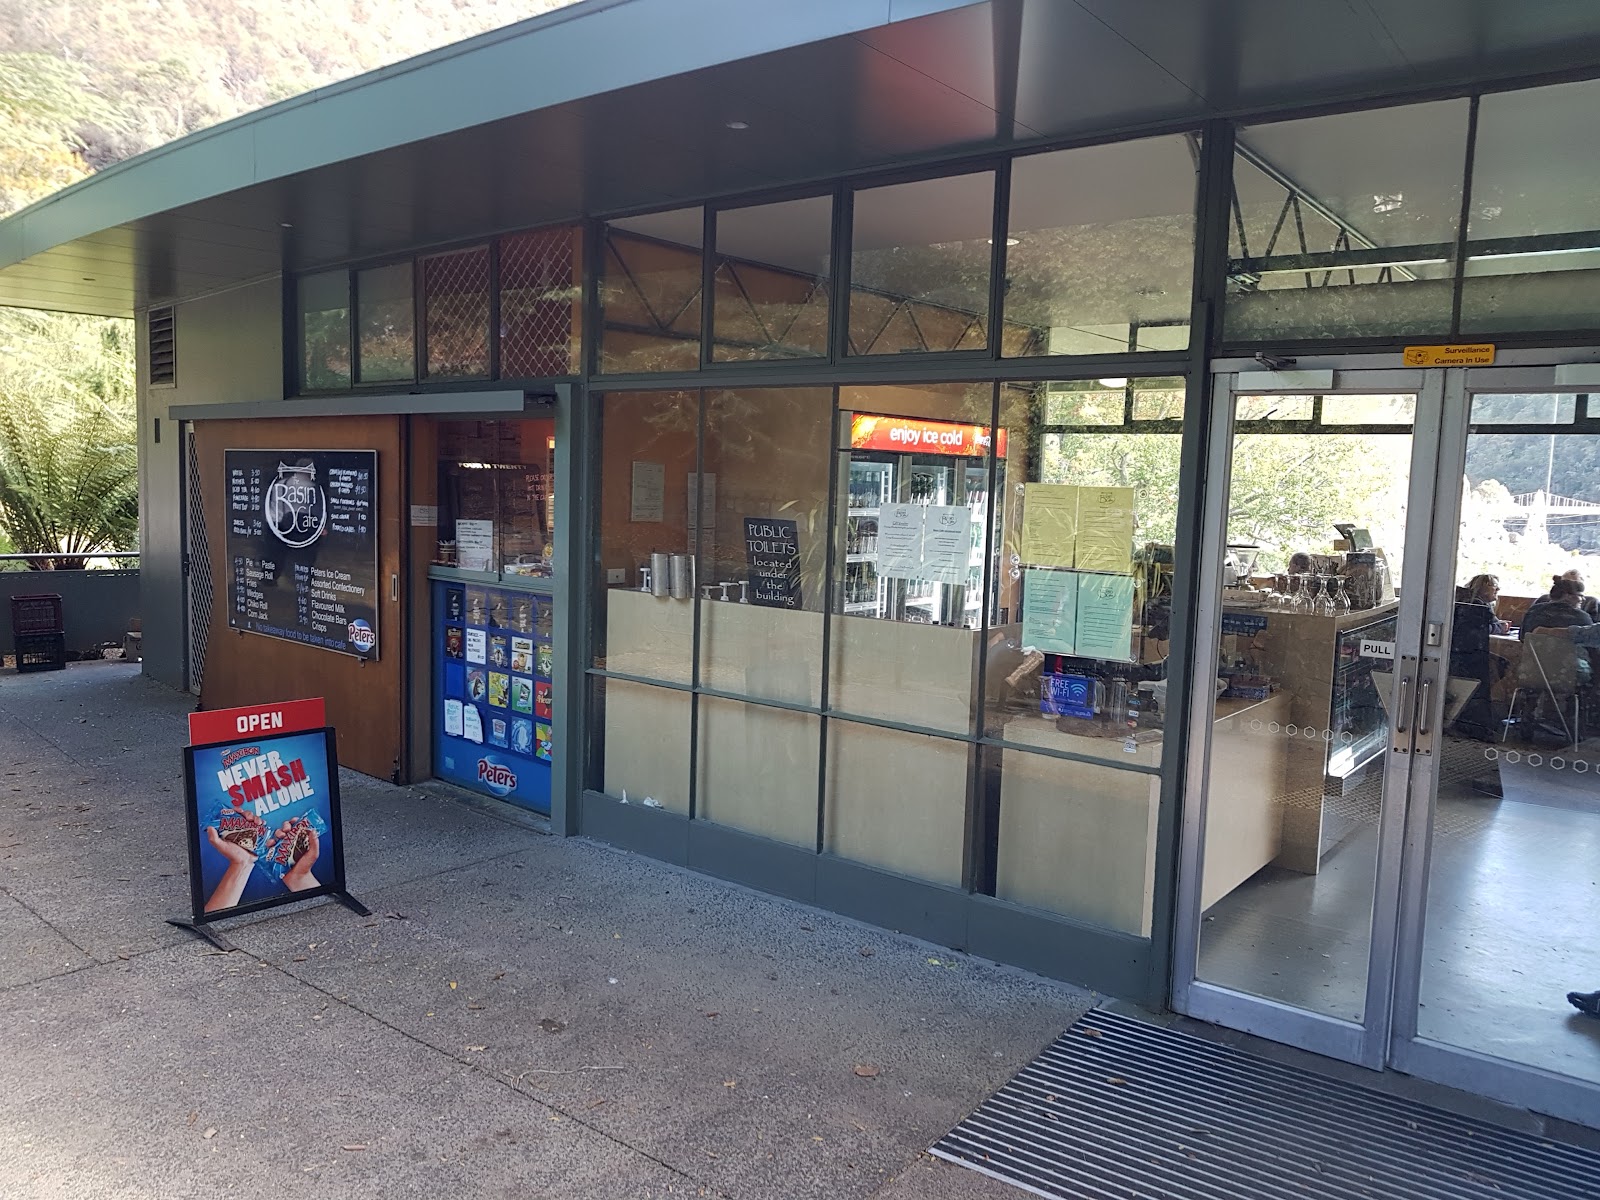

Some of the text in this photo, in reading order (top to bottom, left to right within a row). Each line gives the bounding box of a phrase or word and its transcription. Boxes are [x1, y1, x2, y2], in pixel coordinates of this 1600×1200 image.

[1445, 346, 1490, 354] Surveillance
[890, 426, 920, 447] enjoy
[922, 428, 939, 444] ice
[941, 430, 964, 446] cold
[274, 484, 316, 534] Basin
[749, 523, 791, 539] PUBLIC
[747, 540, 796, 555] TOILETS
[246, 557, 254, 567] Pie
[753, 555, 792, 569] located
[246, 568, 264, 580] Sausage
[264, 571, 274, 580] Roll
[310, 566, 326, 578] Peters
[335, 570, 352, 580] Cream
[759, 568, 788, 579] under
[246, 579, 257, 588] Fries
[311, 578, 332, 590] Assorted
[332, 581, 366, 597] Confectionery
[766, 579, 783, 590] the
[246, 588, 264, 601] Wedges
[311, 588, 321, 598] Soft
[321, 590, 337, 602] Drinks
[756, 588, 795, 606] building
[247, 599, 268, 611] Chiko Roll
[311, 599, 346, 614] Flavoured Milk
[258, 611, 269, 621] Jack
[311, 610, 348, 626] Chocolate Bars
[311, 620, 327, 634] Crisps
[263, 623, 285, 637] takeaway
[285, 627, 297, 639] food
[297, 631, 303, 639] to
[303, 632, 309, 641] be
[310, 634, 324, 643] taken
[324, 636, 335, 647] into
[348, 623, 375, 646] Peters
[1363, 644, 1391, 655] PULL
[1050, 678, 1070, 689] FREE
[1050, 686, 1070, 698] WI-FI
[236, 711, 283, 733] OPEN
[222, 746, 261, 768] MAXIBON
[217, 750, 283, 792] NEVER
[478, 759, 516, 788] Peters
[228, 758, 307, 807] SMASH
[255, 775, 315, 817] ALONE
